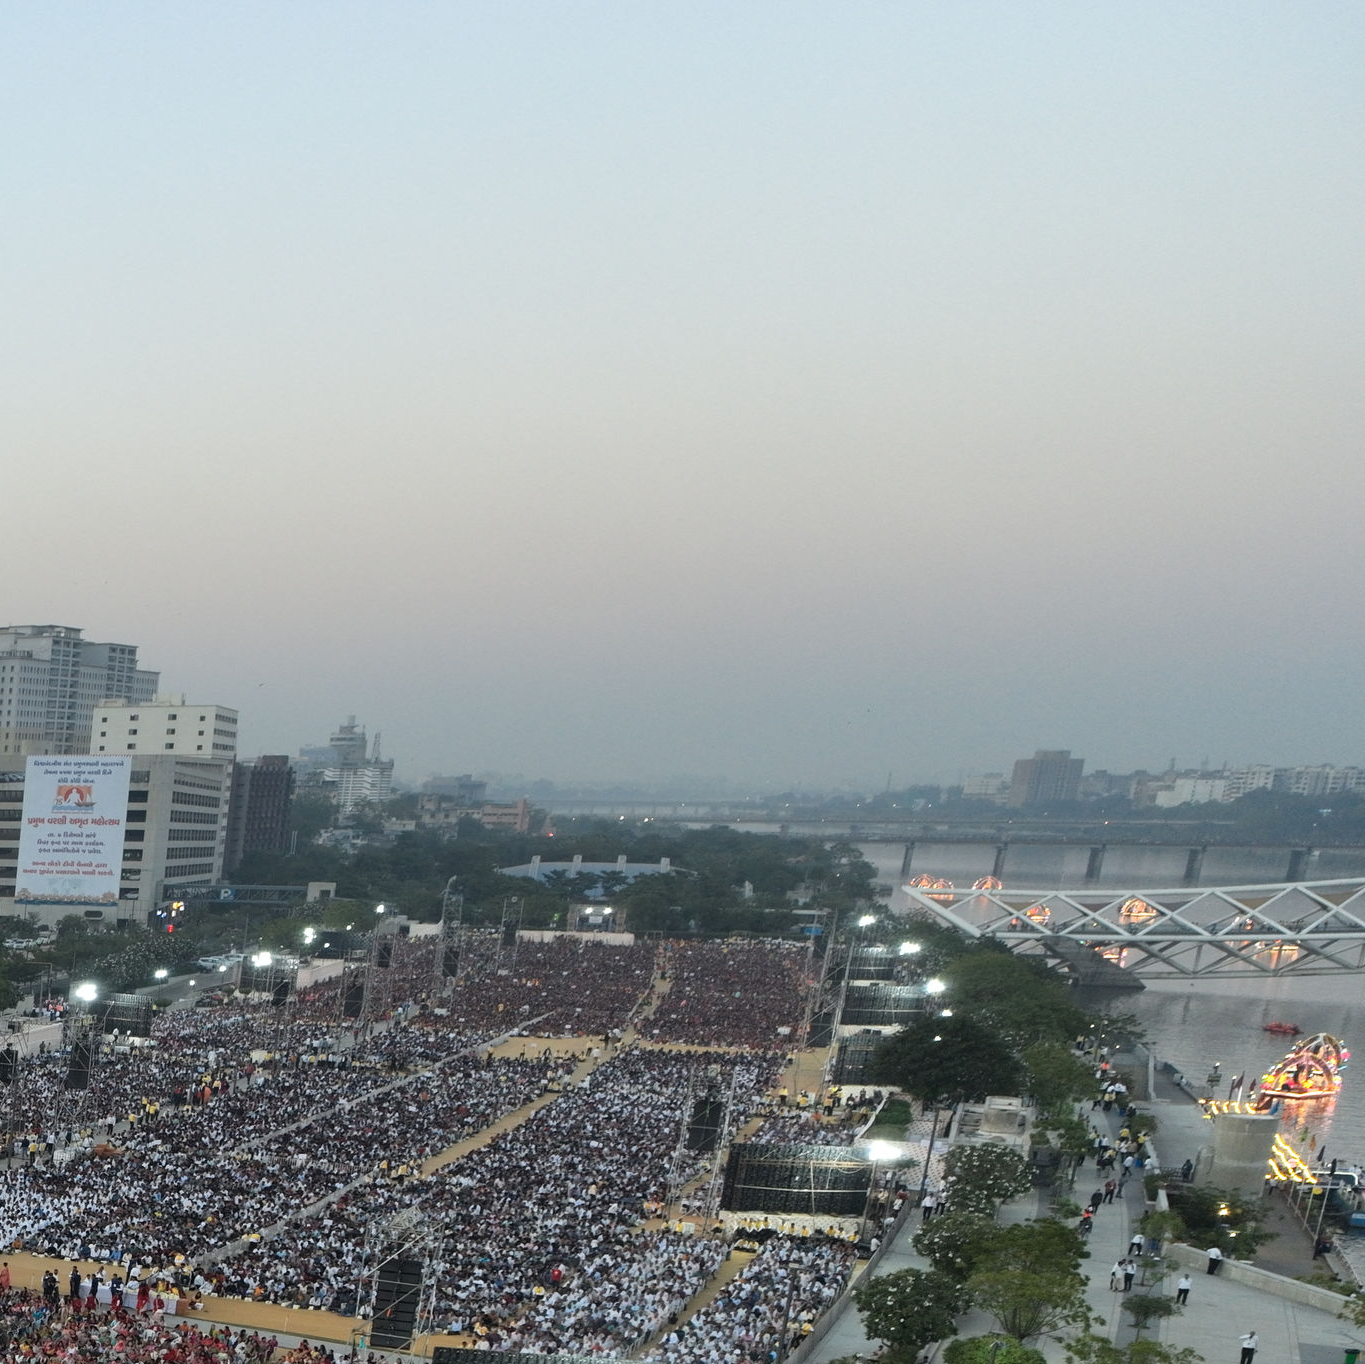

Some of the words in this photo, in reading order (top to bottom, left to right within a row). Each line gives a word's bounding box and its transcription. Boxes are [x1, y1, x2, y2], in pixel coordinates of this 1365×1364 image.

[28, 817, 45, 827] પ્રમુખ
[47, 816, 67, 825] વરણી
[69, 817, 88, 828] અમૃત
[91, 816, 120, 826] મહોત્સવ
